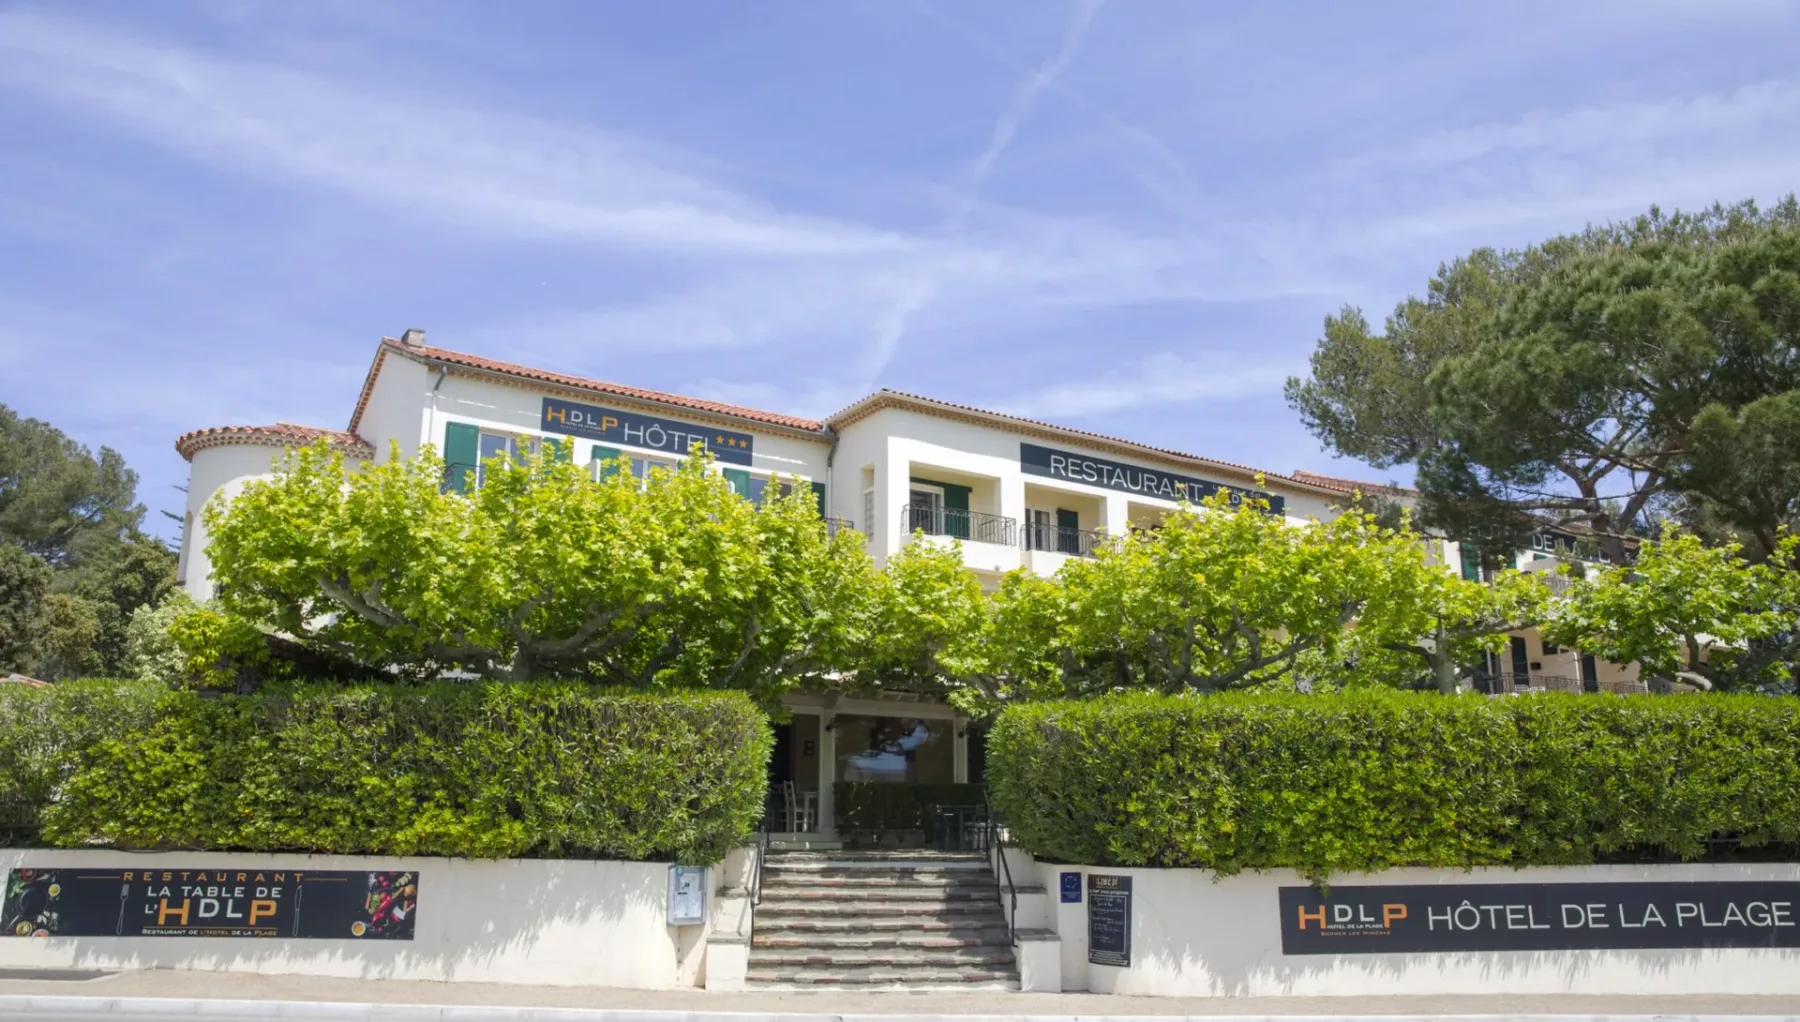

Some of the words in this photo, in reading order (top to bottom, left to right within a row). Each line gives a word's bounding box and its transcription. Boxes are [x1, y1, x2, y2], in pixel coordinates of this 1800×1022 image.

[547, 405, 618, 432] HDLP
[1050, 454, 1203, 501] RESTAURANT
[1532, 533, 1554, 552] DE
[123, 871, 304, 883] RESTAURANT
[147, 886, 171, 897] LA
[181, 886, 245, 897] TABLE
[256, 887, 282, 898] DE
[1298, 904, 1407, 930] HDLP
[1428, 900, 1550, 931] HÔTEL
[1561, 904, 1609, 928] DE
[1619, 903, 1667, 928] LA
[1675, 901, 1796, 927] PLAGE
